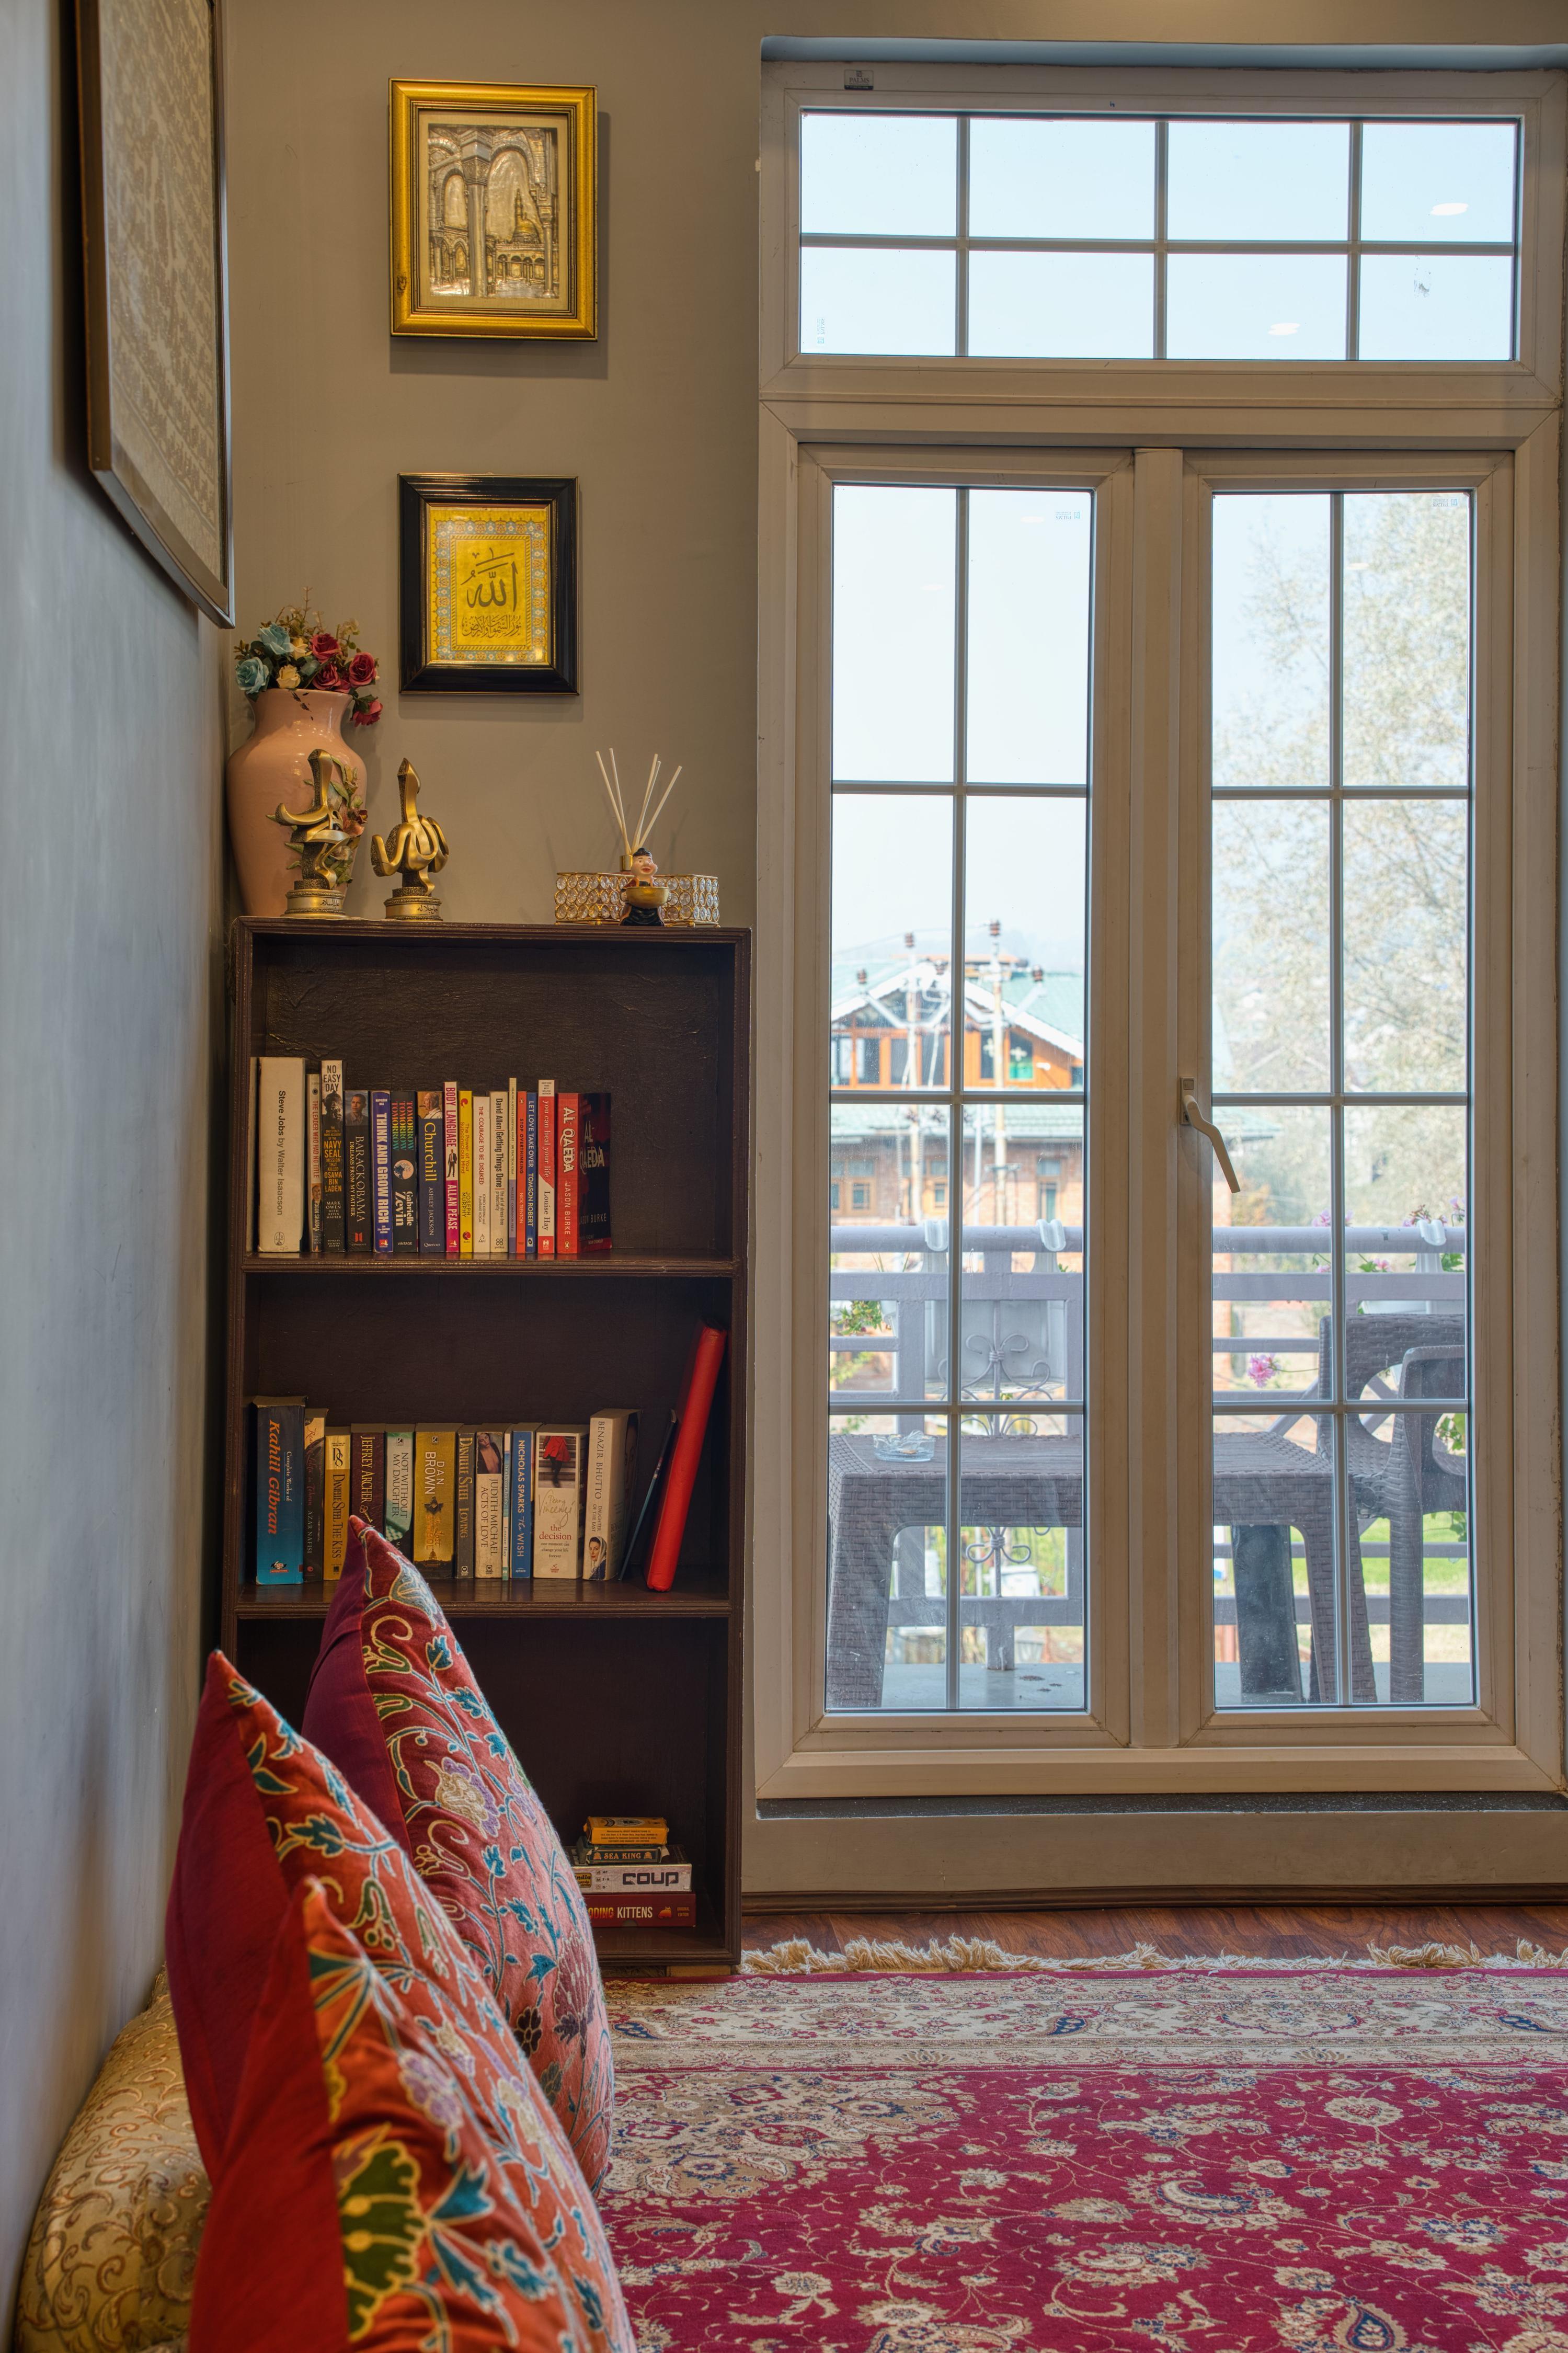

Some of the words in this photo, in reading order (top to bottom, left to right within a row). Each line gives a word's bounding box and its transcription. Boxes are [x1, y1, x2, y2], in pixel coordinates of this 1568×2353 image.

[323, 1074, 341, 1083] EASY
[327, 1065, 337, 1073] NO
[325, 1083, 339, 1092] DAY
[445, 1087, 456, 1106] BODY
[564, 1106, 576, 1126] AL-
[376, 1113, 387, 1143] THINK
[446, 1110, 456, 1147] LANGUAGE
[277, 1138, 285, 1148] by
[324, 1140, 341, 1149] NAVY
[324, 1149, 341, 1158] SEAL
[424, 1122, 437, 1181] Churchill
[494, 1132, 504, 1152] Getting
[560, 1128, 575, 1173] QAEDA
[356, 1136, 365, 1180] BARACK
[377, 1144, 388, 1164] AND
[494, 1152, 504, 1171] Things
[579, 1146, 605, 1175] QAEDA
[350, 1184, 356, 1193] MY
[377, 1166, 388, 1197] GROW
[356, 1181, 365, 1222] OBAMA
[447, 1184, 457, 1206] ALLAN
[377, 1199, 389, 1223] RICH
[395, 1191, 407, 1226] Zevin
[448, 1208, 457, 1230] PEASE
[590, 1213, 606, 1223] BURKE
[542, 1217, 551, 1230] Hay
[269, 1419, 281, 1472] Kahlil
[596, 1421, 605, 1459] BENAZIR
[360, 1435, 375, 1469] JEFFREY
[393, 1454, 400, 1467] MY
[460, 1437, 473, 1474] DANIELLE
[424, 1452, 436, 1494] BROWN
[436, 1461, 445, 1485] DAN
[594, 1462, 603, 1499] BHUTTO
[361, 1470, 375, 1503] ARCHER
[459, 1477, 472, 1501] STEEL
[480, 1486, 489, 1509] ACTS
[489, 1478, 498, 1513] JUDITH
[268, 1477, 281, 1535] Gibran
[480, 1511, 489, 1523] OF
[539, 1489, 575, 1527] Vincenzi
[333, 1523, 343, 1538] THE
[459, 1507, 469, 1538] LOVING
[539, 1531, 571, 1540] decision
[332, 1540, 343, 1559] KISS
[623, 1872, 679, 1887] COUP
[588, 1907, 614, 1920] ODING
[617, 1906, 653, 1918] KITTENS
